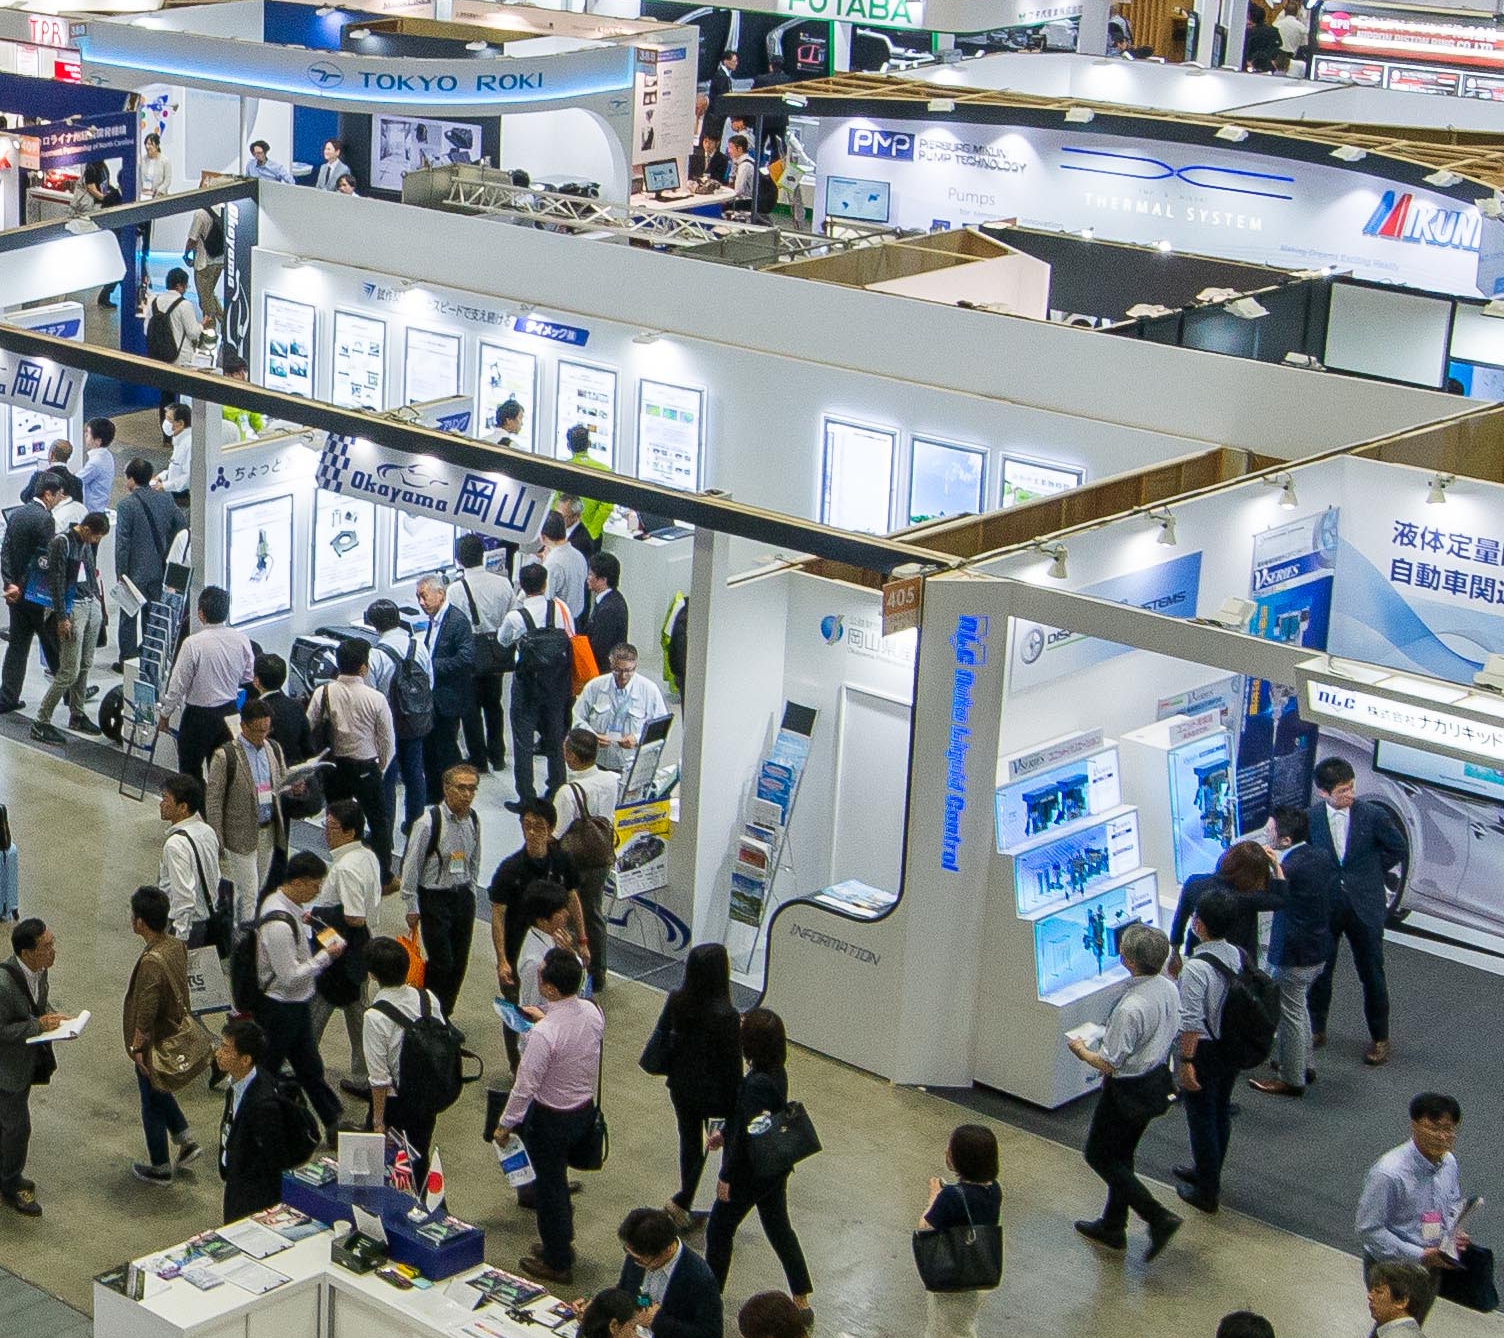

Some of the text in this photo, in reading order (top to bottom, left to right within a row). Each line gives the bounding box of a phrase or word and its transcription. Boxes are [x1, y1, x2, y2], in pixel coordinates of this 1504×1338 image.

[28, 19, 62, 46] TPR
[358, 71, 543, 92] TOKYO ROKI
[853, 129, 911, 158] PMP
[918, 138, 969, 154] PIERBURG
[918, 150, 1027, 173] PUMP TECHNOLOGY
[947, 187, 996, 207] Pumps
[1083, 192, 1264, 232] THERMAL SYSTEM
[225, 202, 239, 289] Okayama
[12, 358, 73, 411] 岡山
[350, 469, 536, 533] Okayama 岡山
[886, 589, 916, 609] 405
[790, 923, 882, 966] INFORMATION
